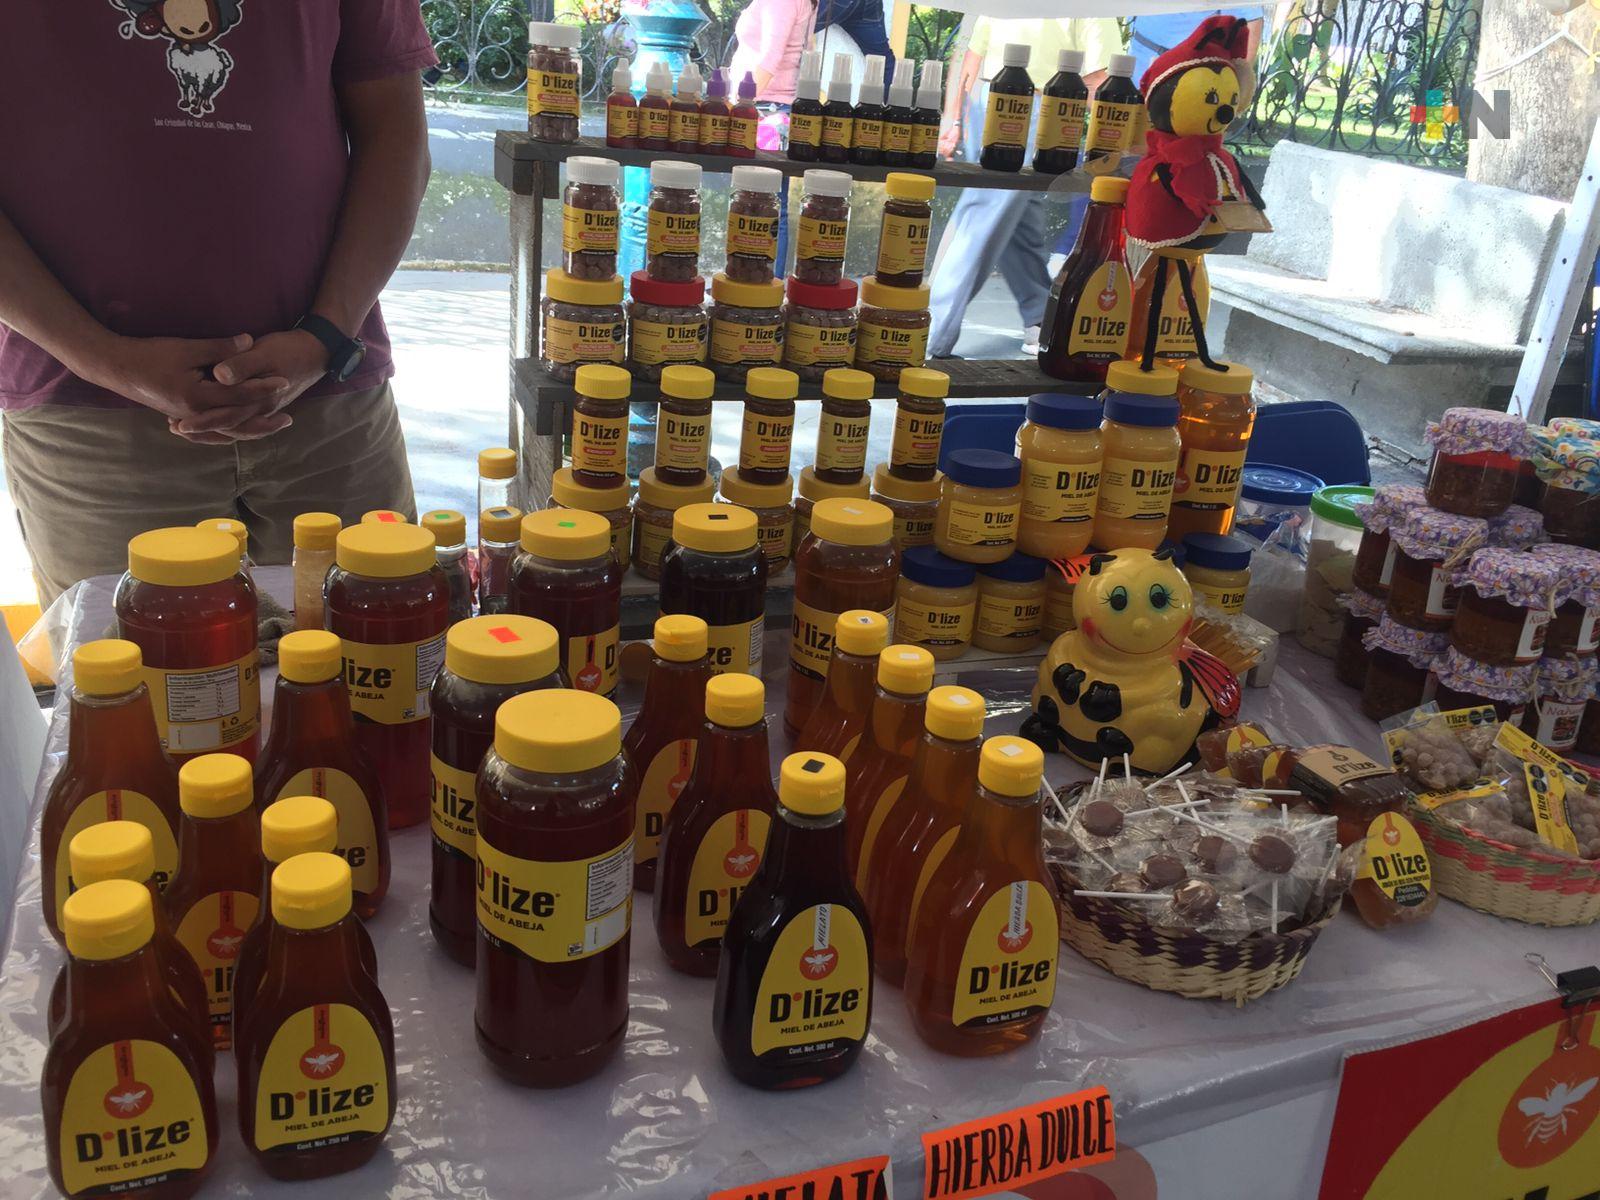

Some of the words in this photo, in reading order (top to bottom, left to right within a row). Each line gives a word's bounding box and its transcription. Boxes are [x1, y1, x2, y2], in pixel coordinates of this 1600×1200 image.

[493, 911, 506, 924] DE
[507, 917, 545, 932] ABEJA
[979, 996, 998, 1005] MIEL
[1000, 993, 1011, 1001] DE
[1012, 988, 1038, 999] ABEJA
[780, 1024, 802, 1034] MIEL
[803, 1022, 816, 1032] DE
[817, 1019, 845, 1030] ABEJA
[285, 1123, 309, 1132] MIEL
[311, 1120, 325, 1128] DE
[327, 1113, 360, 1125] ABEJA
[929, 1117, 1033, 1199] HIERBA
[1036, 1094, 1115, 1171] DULCE
[95, 1163, 121, 1173] MIEL
[123, 1160, 138, 1169] DE
[141, 1151, 176, 1165] ABEJA
